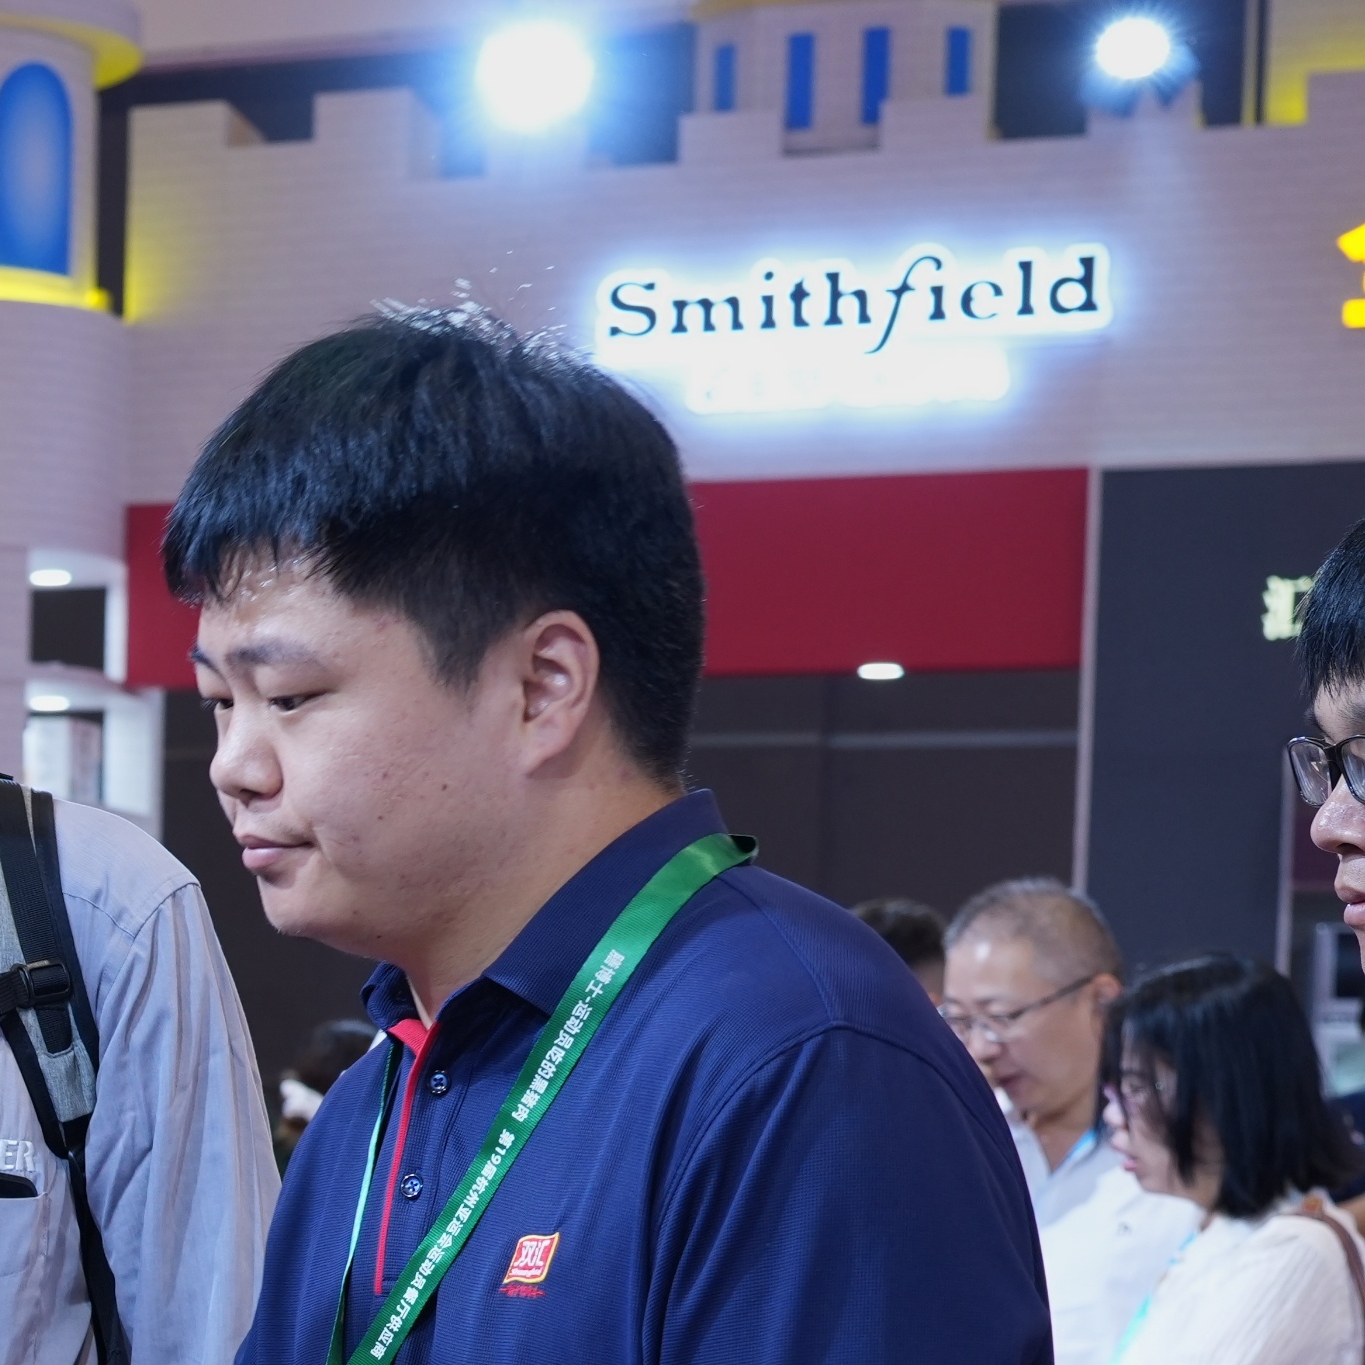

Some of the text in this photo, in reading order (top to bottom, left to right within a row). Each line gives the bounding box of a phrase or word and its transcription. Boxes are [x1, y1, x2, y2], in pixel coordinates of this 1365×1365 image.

[609, 254, 1098, 354] Smithfield
[368, 1128, 515, 1360] 第19届杭州亚运会运动员餐厅供应商
